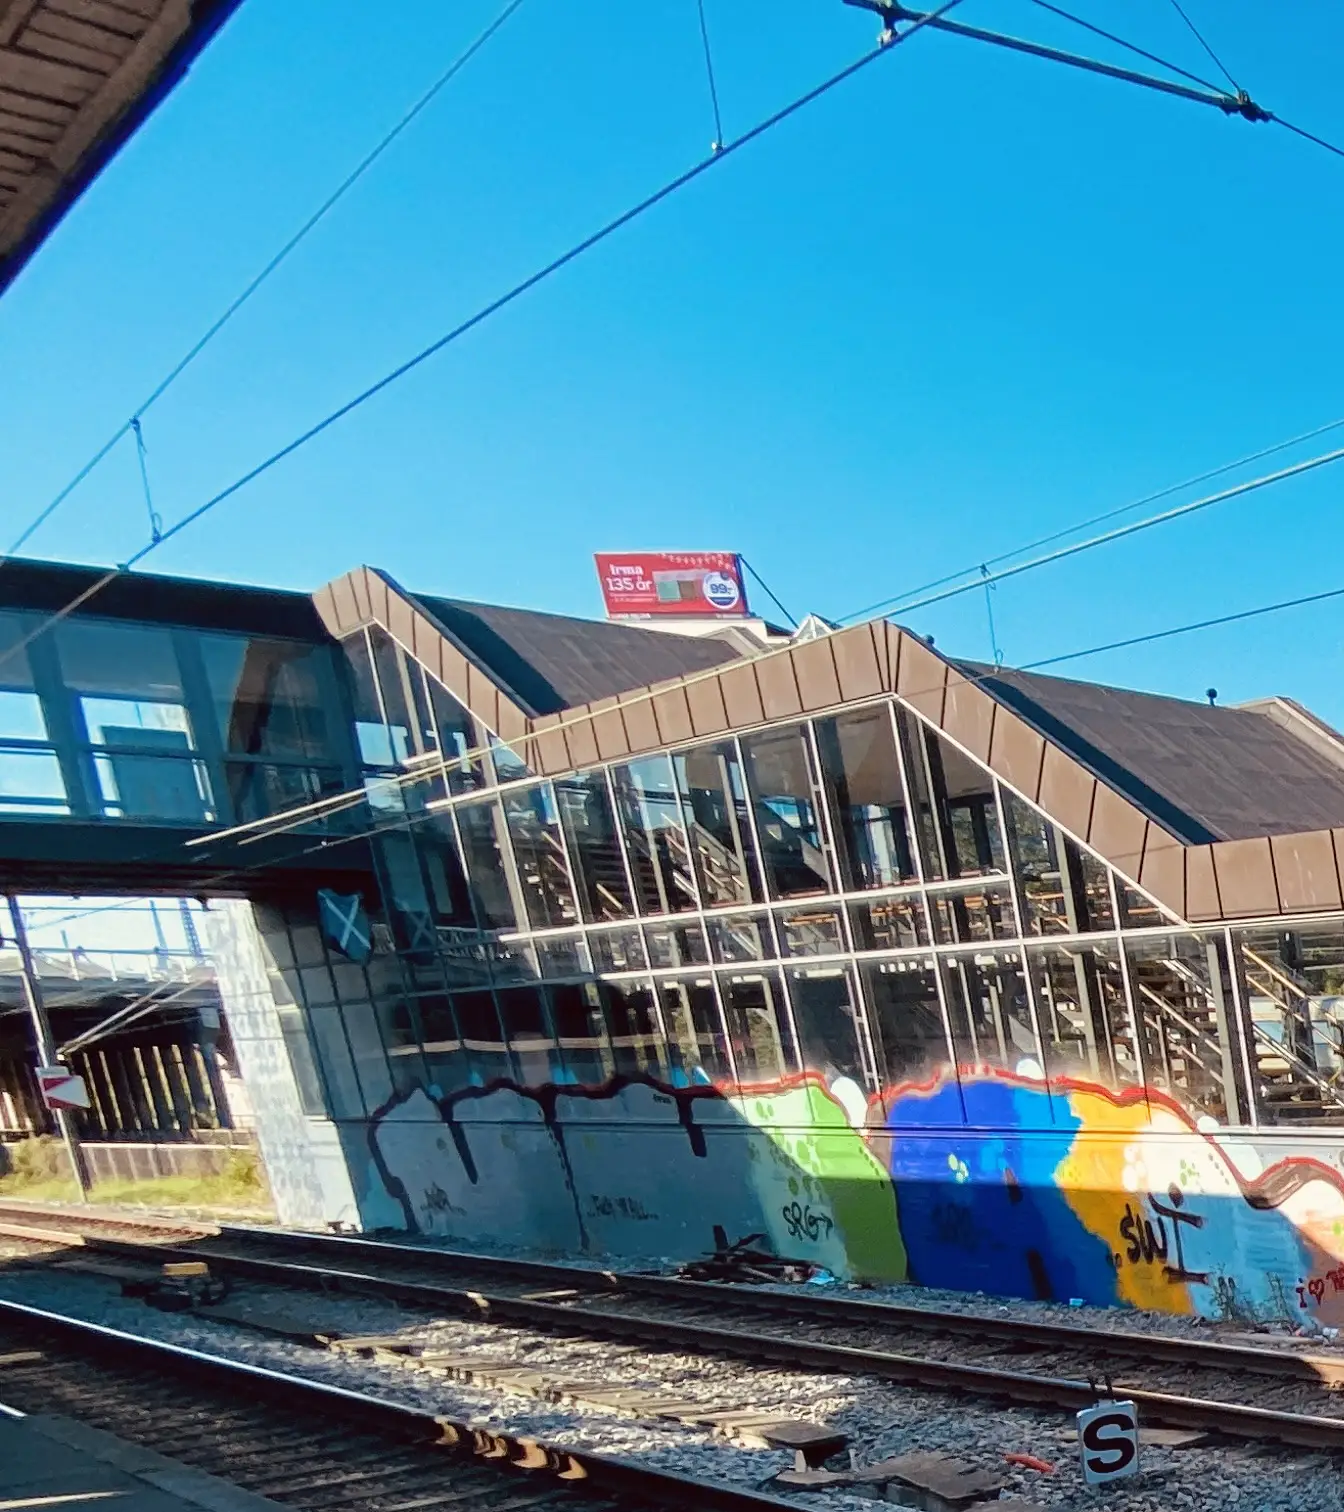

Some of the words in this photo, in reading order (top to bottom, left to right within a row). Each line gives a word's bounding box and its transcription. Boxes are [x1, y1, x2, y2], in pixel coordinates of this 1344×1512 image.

[609, 563, 643, 576] Irma
[606, 577, 634, 592] 135
[1083, 1413, 1135, 1474] S
